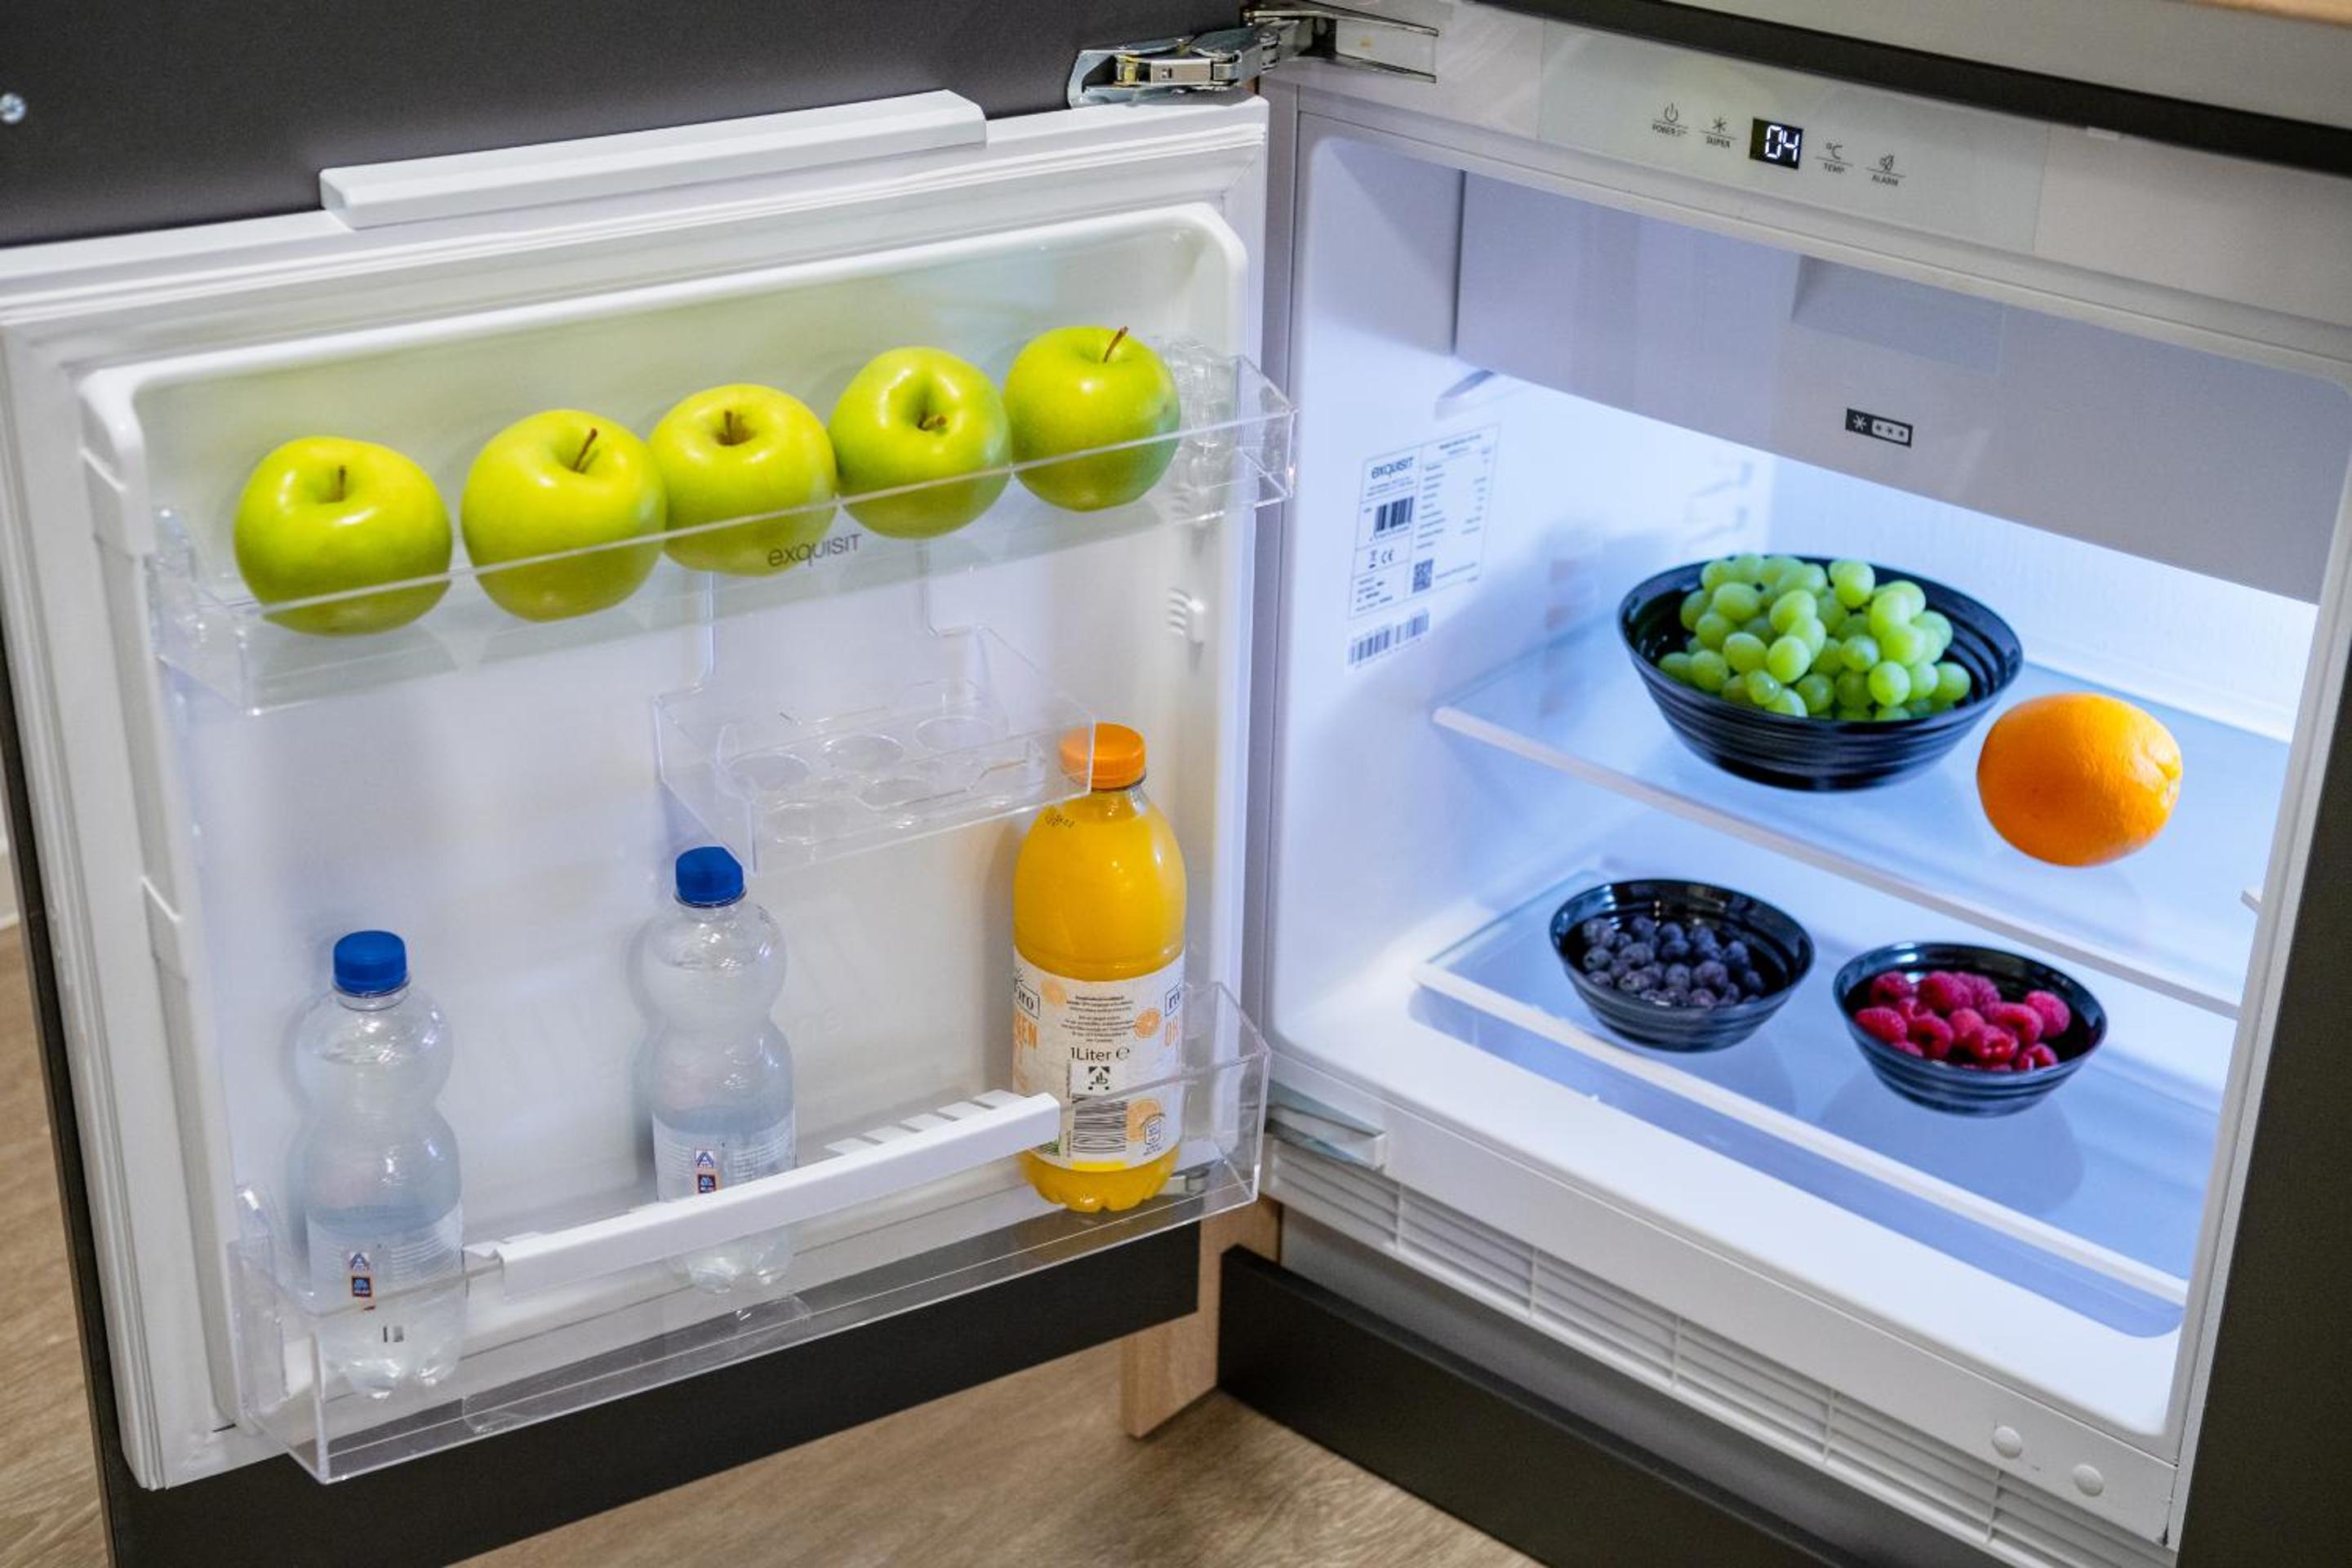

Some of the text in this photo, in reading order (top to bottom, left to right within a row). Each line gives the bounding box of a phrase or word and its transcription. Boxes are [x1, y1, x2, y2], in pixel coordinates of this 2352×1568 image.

[1764, 124, 1801, 162] 04
[1824, 162, 1845, 174] TEMP
[1872, 174, 1899, 186] ALARM
